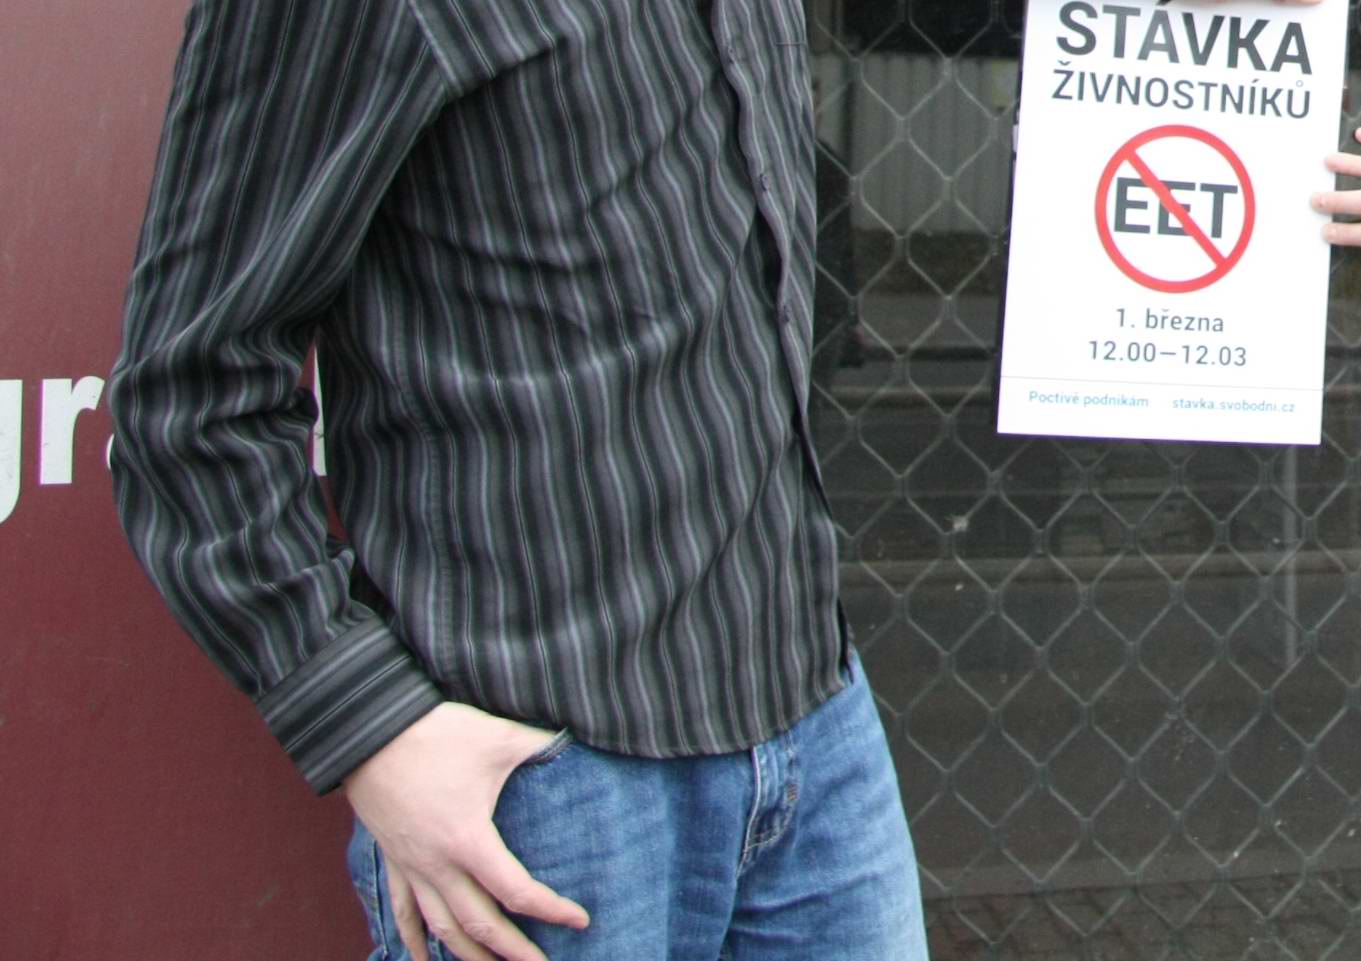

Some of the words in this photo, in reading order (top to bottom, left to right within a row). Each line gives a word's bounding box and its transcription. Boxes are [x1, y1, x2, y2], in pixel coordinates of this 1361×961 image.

[1052, 60, 1311, 119] ŽIVNOSTNÍKŮ
[1113, 177, 1238, 238] EET
[1115, 308, 1135, 329] 1.
[1145, 307, 1224, 332] března
[1083, 393, 1149, 407] podnikám
